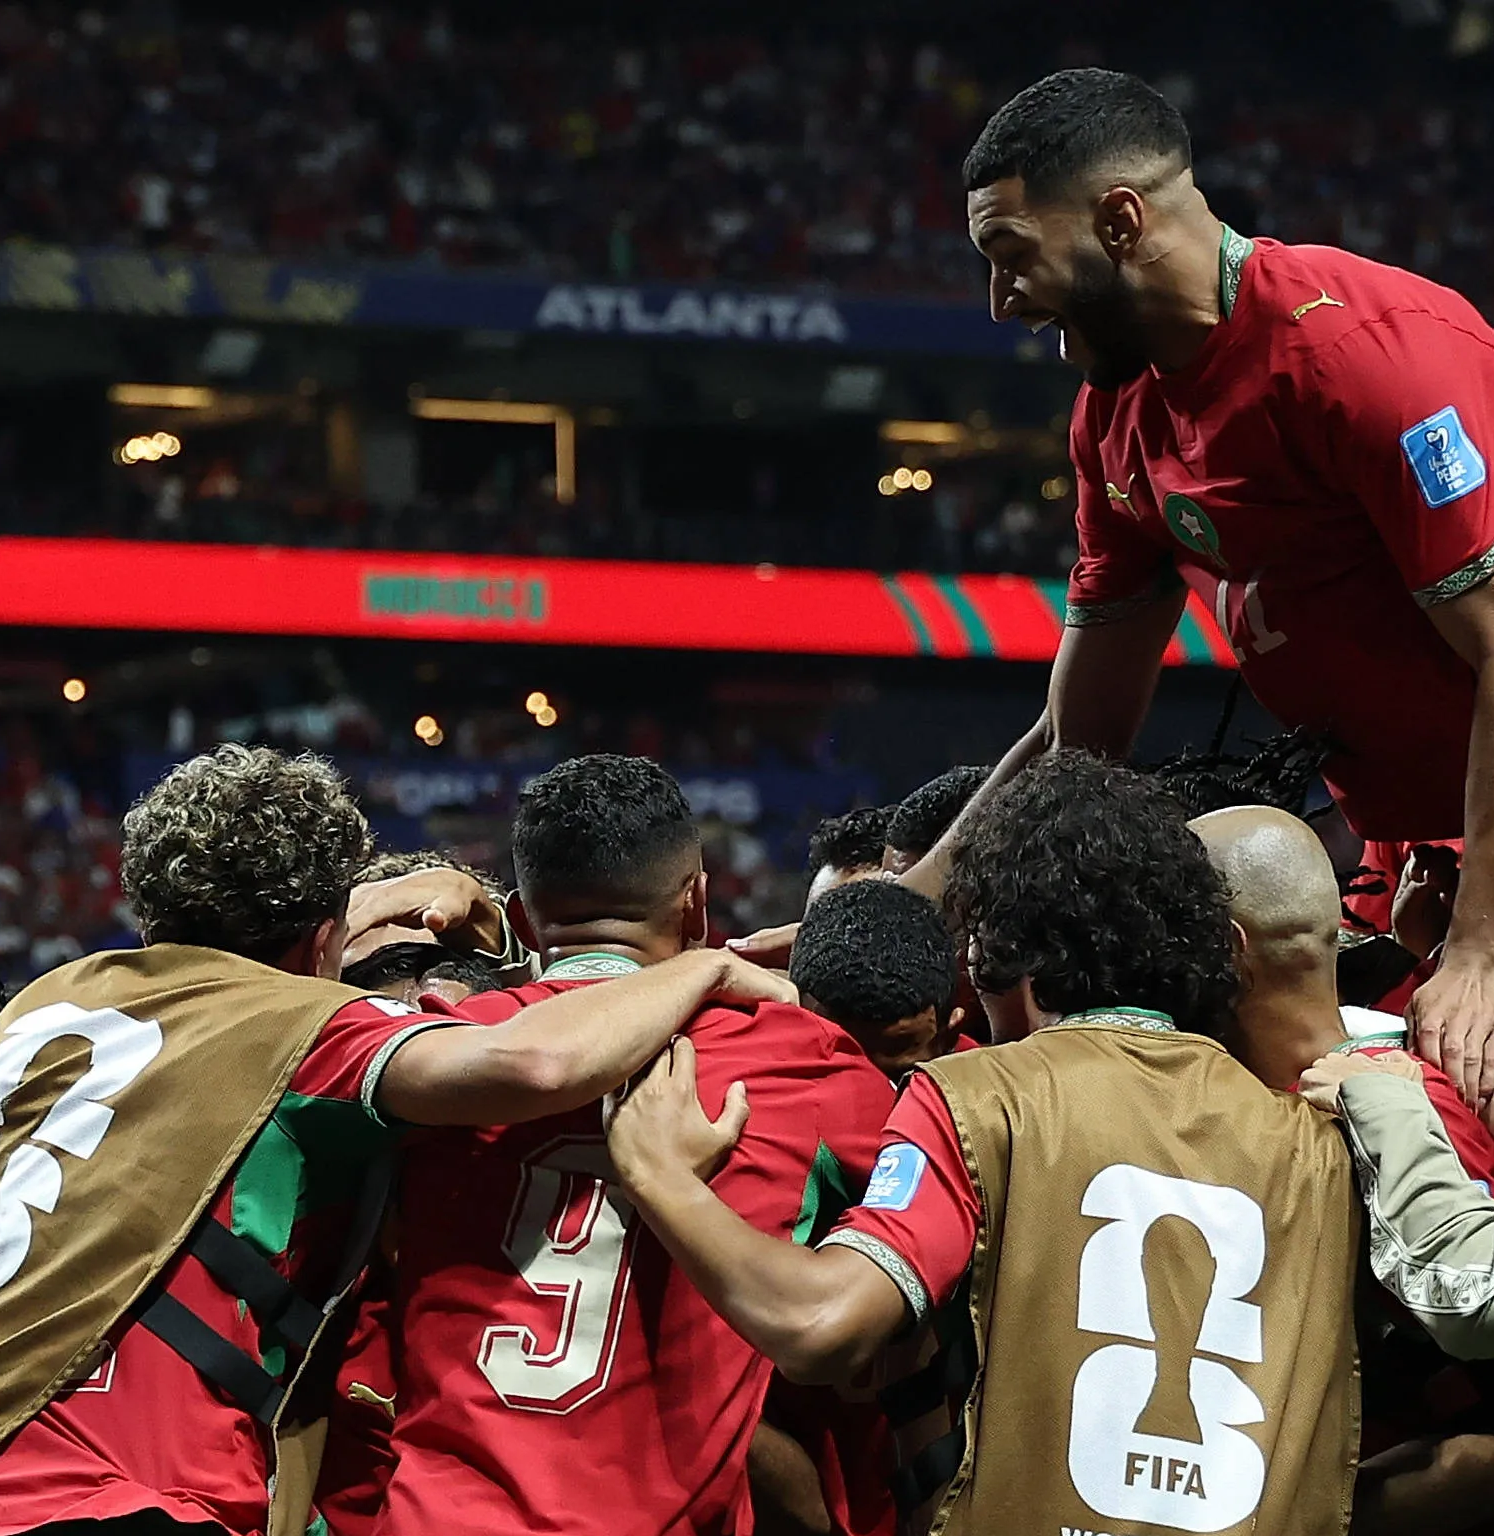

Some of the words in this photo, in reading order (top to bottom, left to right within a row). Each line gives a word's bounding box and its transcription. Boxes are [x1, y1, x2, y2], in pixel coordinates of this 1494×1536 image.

[537, 286, 848, 344] ATLANTA
[477, 1134, 641, 1414] 9
[1124, 1451, 1208, 1500] FIFA
